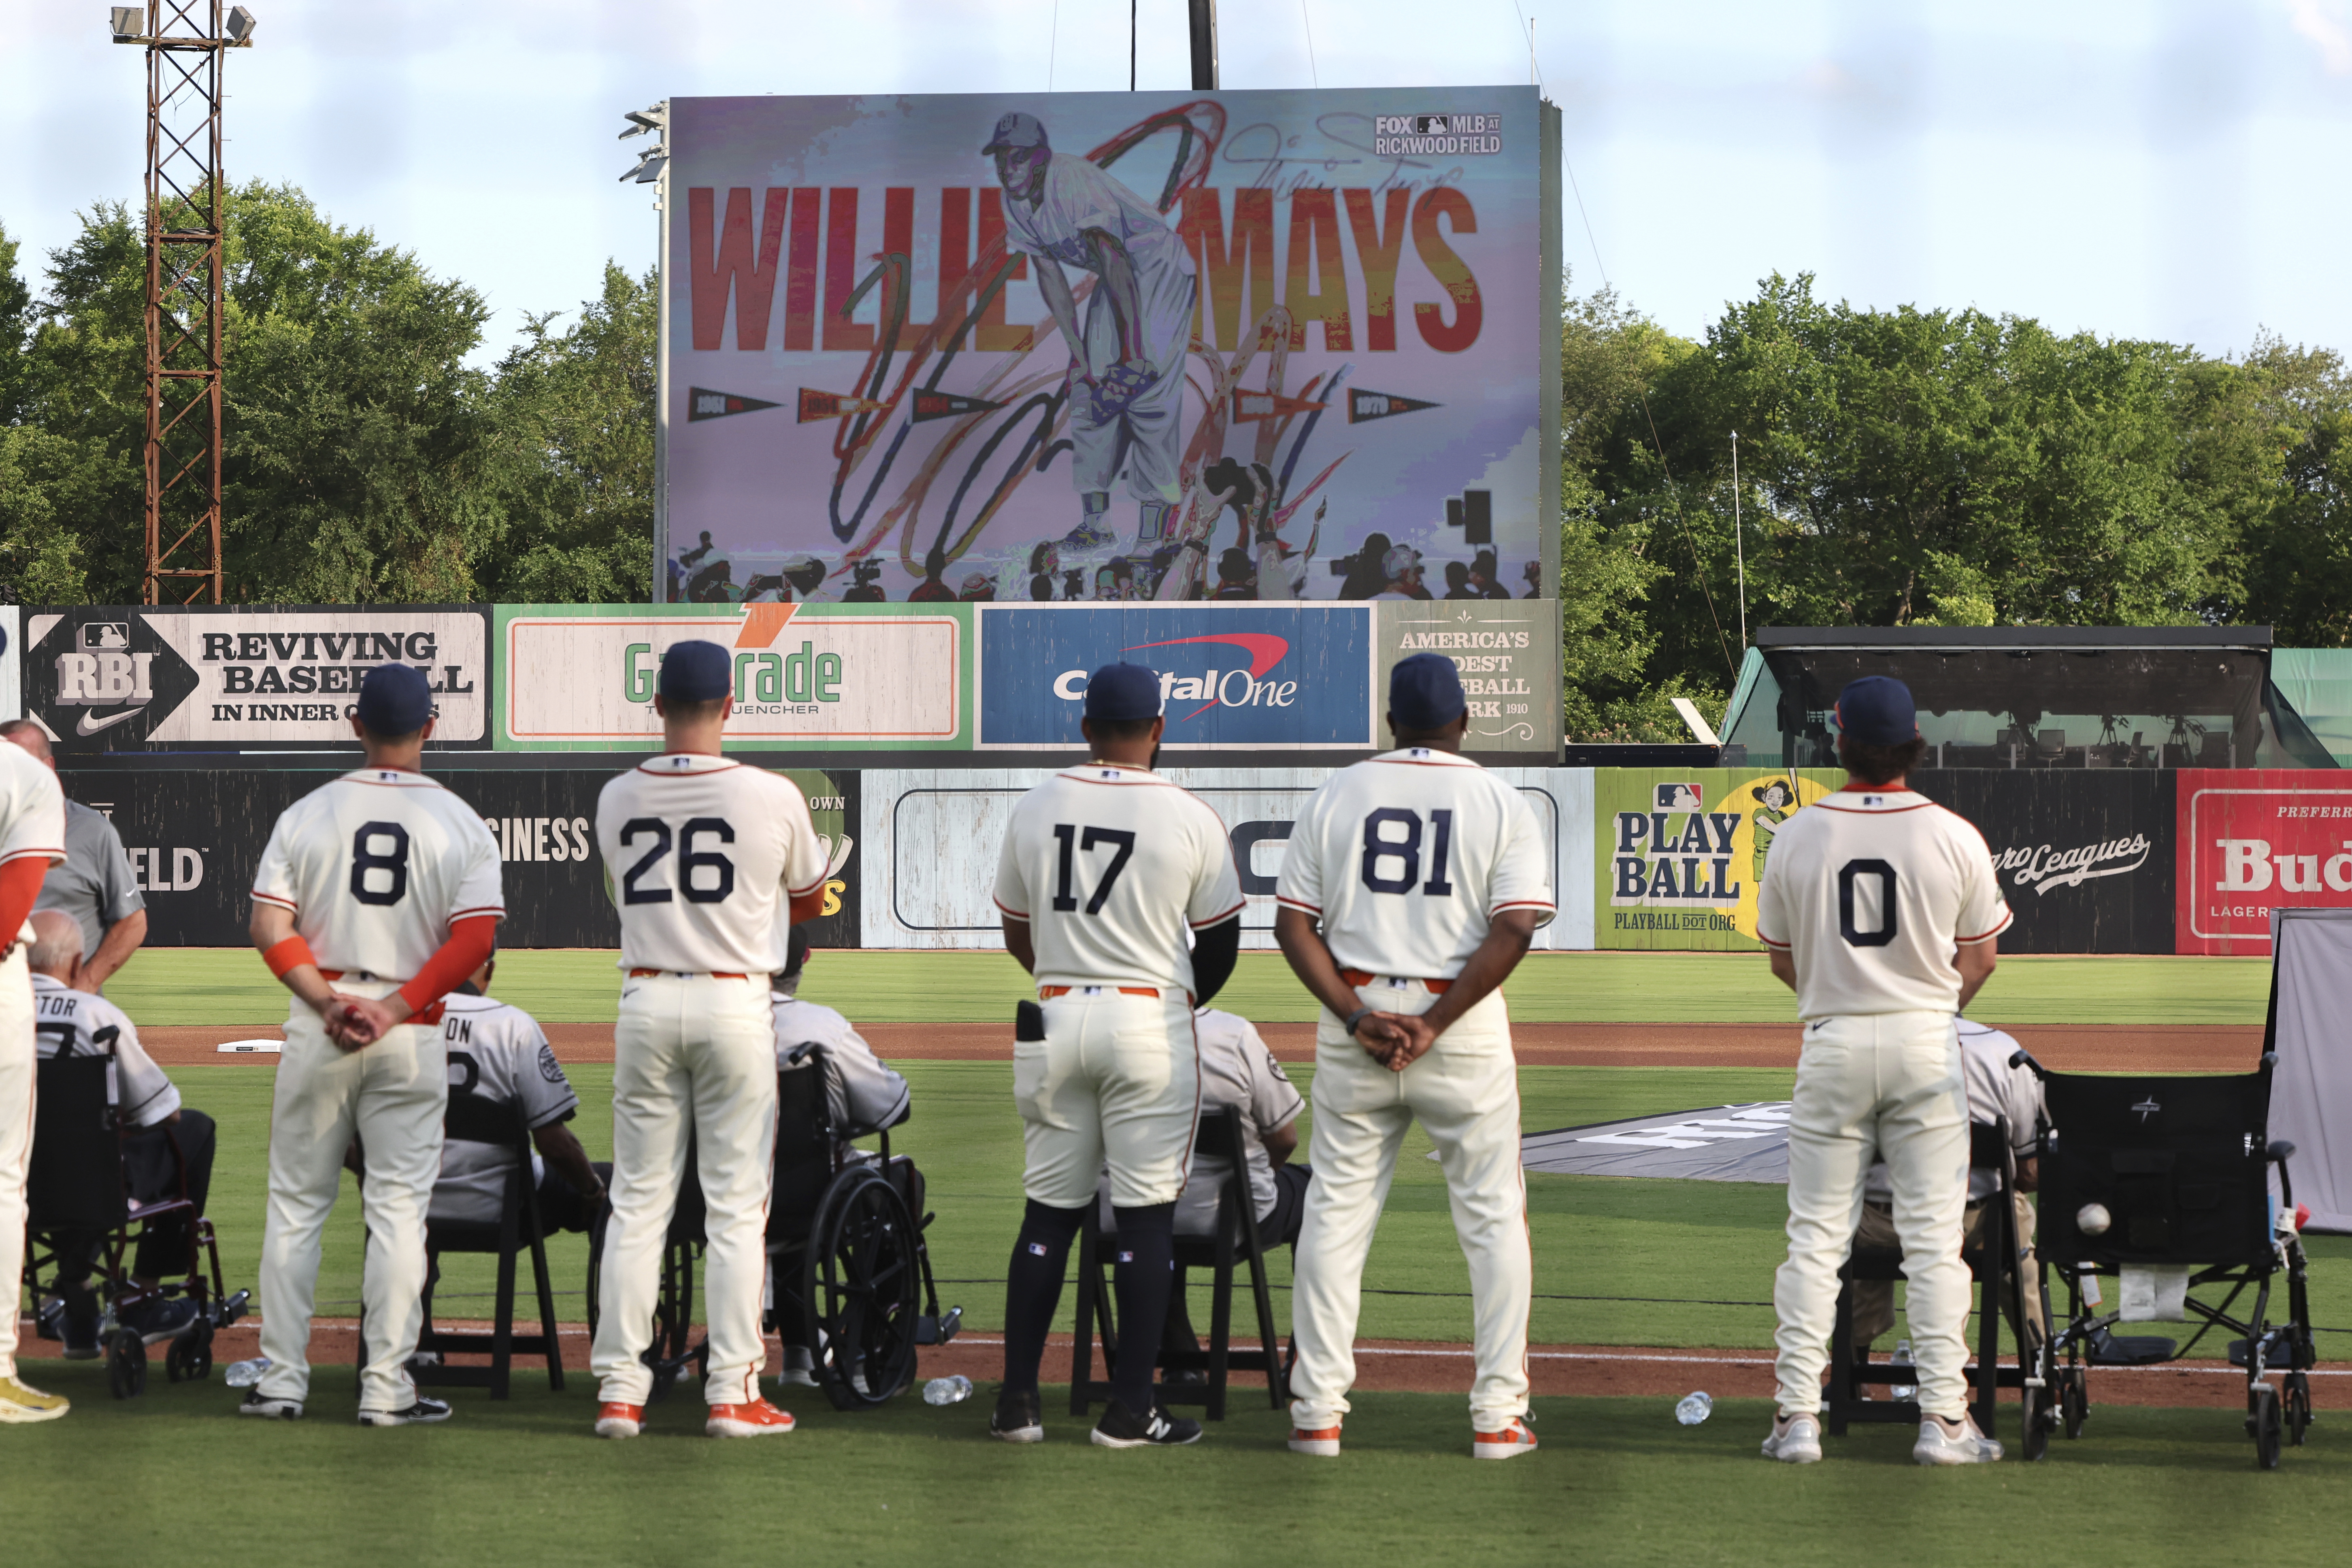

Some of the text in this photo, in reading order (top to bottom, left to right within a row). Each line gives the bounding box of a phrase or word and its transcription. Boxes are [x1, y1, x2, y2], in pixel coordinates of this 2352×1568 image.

[1376, 115, 1499, 134] FOX MLB AT
[1376, 136, 1500, 154] RICKWOOD FIELD
[688, 186, 1483, 352] WILLIE MAYS
[202, 632, 437, 660] REVIVING
[1400, 632, 1530, 649] AMERICA'S
[61, 652, 153, 700] RBI
[223, 666, 473, 694] BASELL
[624, 641, 842, 703] Grade
[1448, 655, 1512, 672] DEST
[1053, 669, 1297, 707] Ctal One
[212, 704, 243, 721] IN
[248, 704, 339, 721] INNER
[731, 705, 819, 714] UENCHER
[1466, 701, 1528, 718] RK 1910
[483, 817, 589, 862] INESS
[1362, 808, 1452, 896] 81
[1618, 812, 1741, 854] PLAY
[123, 847, 203, 891] ELD
[351, 821, 409, 906] 8
[620, 817, 734, 906] 26
[1053, 824, 1135, 916] 17
[1616, 857, 1740, 899] BALL
[1991, 833, 2151, 887] gro Leagues
[1615, 913, 1736, 931] PLAYBALL DOT ORG
[1839, 859, 1897, 947] 0
[2211, 906, 2269, 918] LAGER
[36, 996, 77, 1017] TOR
